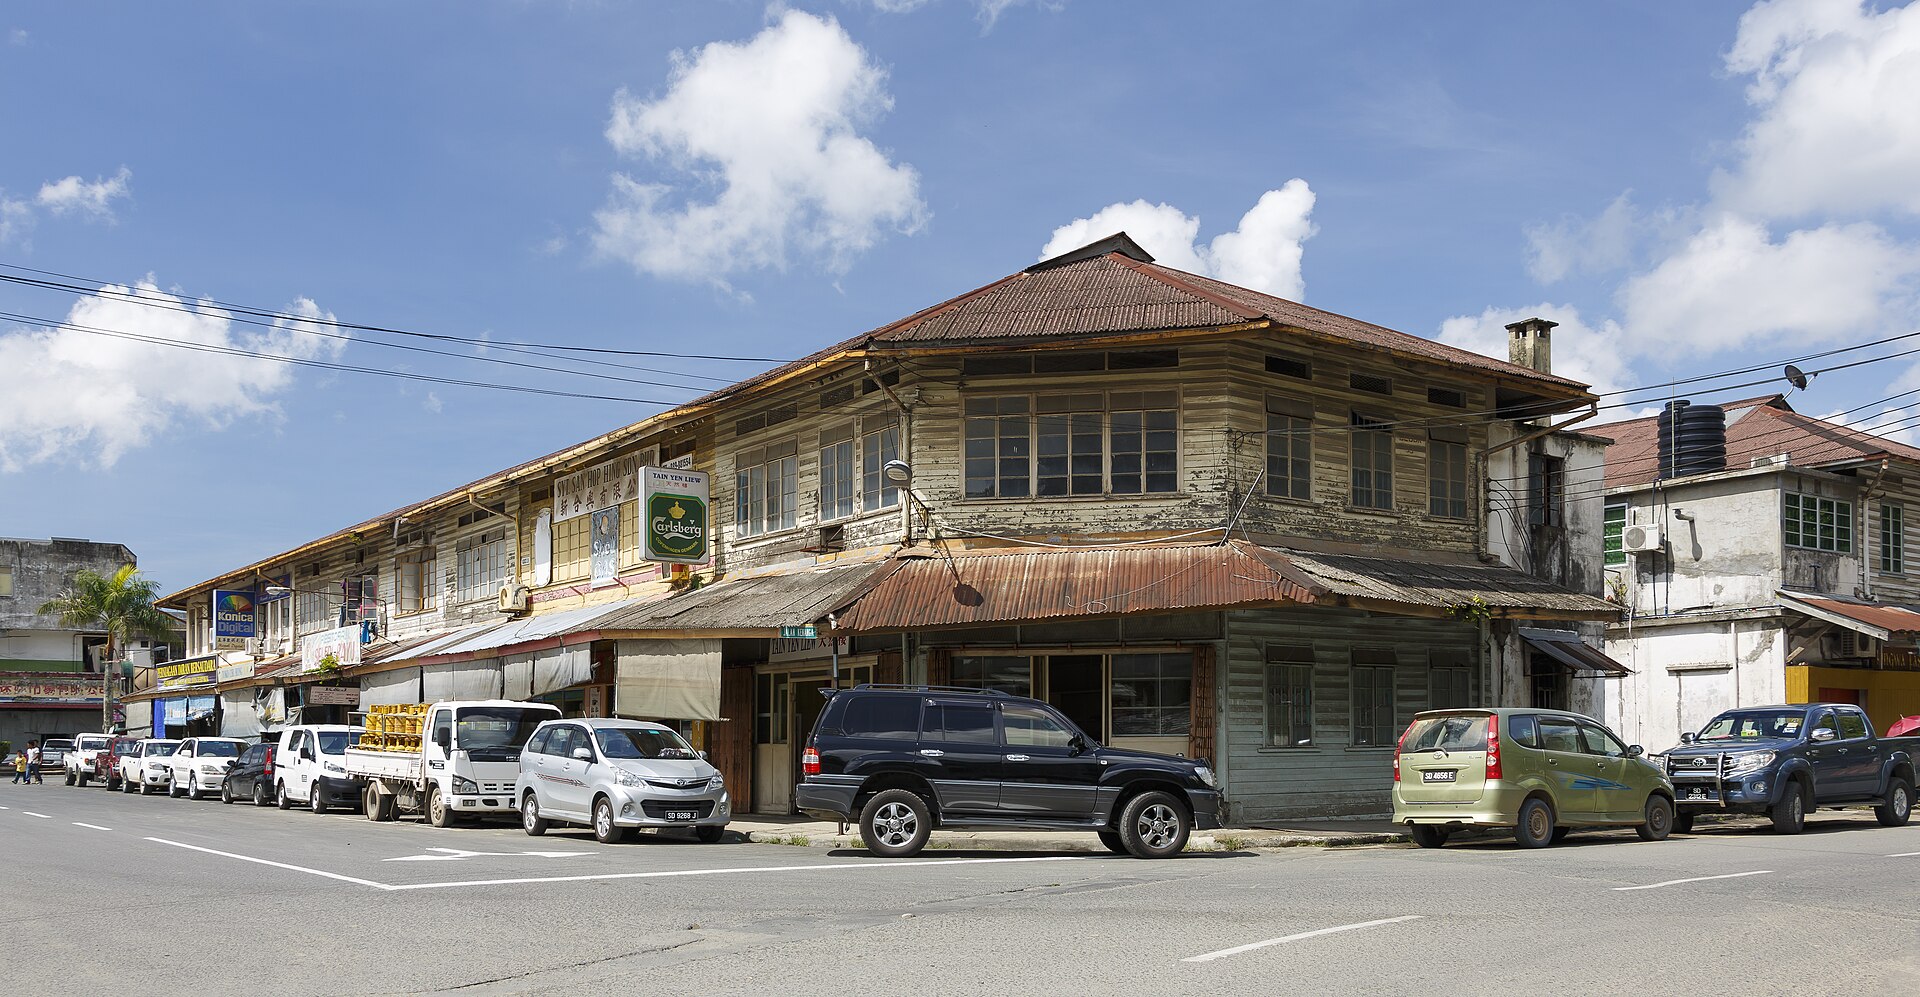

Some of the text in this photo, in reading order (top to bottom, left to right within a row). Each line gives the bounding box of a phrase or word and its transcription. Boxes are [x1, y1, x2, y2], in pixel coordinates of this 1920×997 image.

[572, 475, 585, 493] SAN
[587, 468, 601, 488] HOP
[603, 461, 621, 483] HING
[685, 476, 702, 484] LIEW
[652, 516, 702, 540] Carlsberg
[655, 536, 699, 553] COPENHAGEN DENMARK
[217, 611, 254, 622] Konica
[217, 622, 254, 635] Digital
